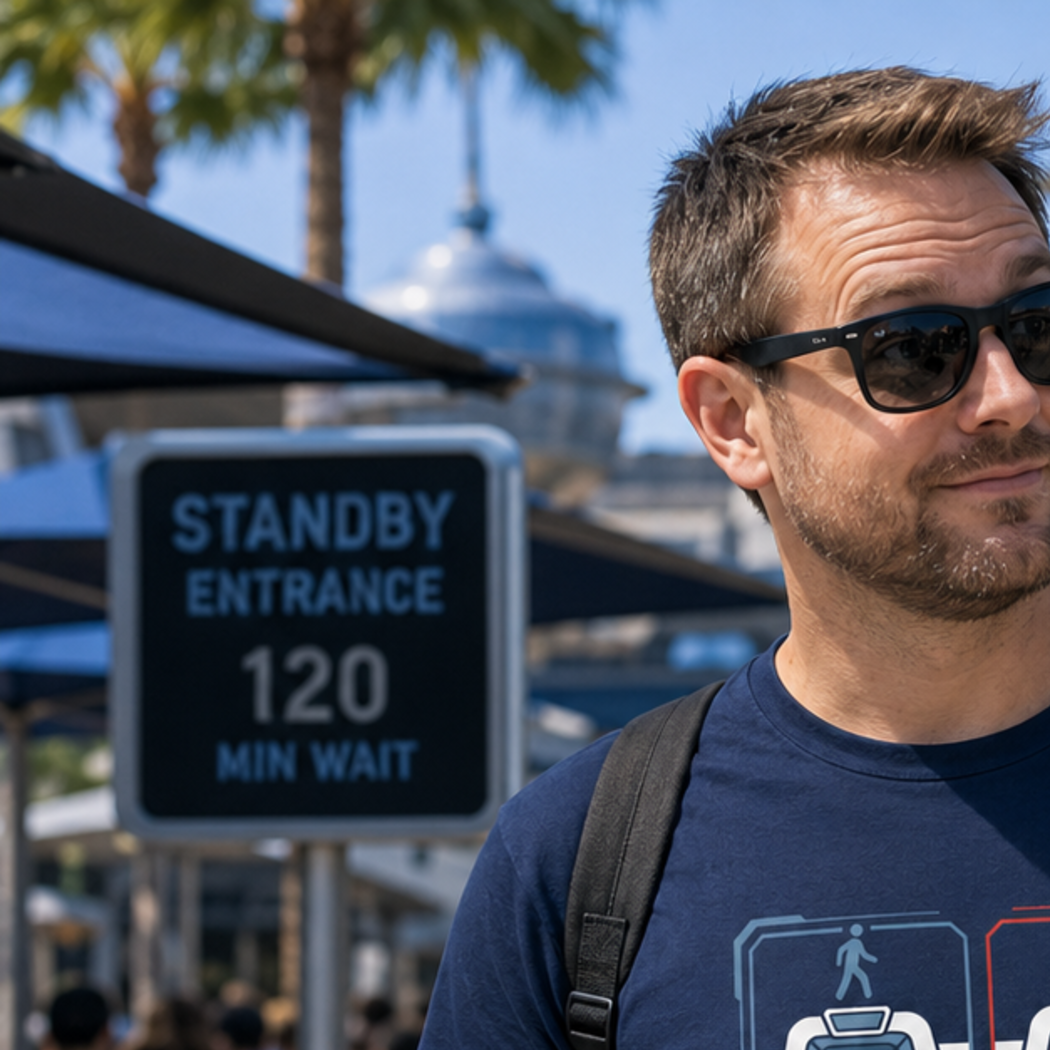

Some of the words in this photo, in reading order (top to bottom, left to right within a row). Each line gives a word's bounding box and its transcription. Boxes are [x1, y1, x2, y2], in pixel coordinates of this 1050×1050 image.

[173, 492, 453, 552] STANDBY
[187, 567, 442, 615] ENTRANCE
[243, 646, 387, 723] 120
[218, 742, 295, 780] MIN
[311, 741, 416, 780] WAIT
